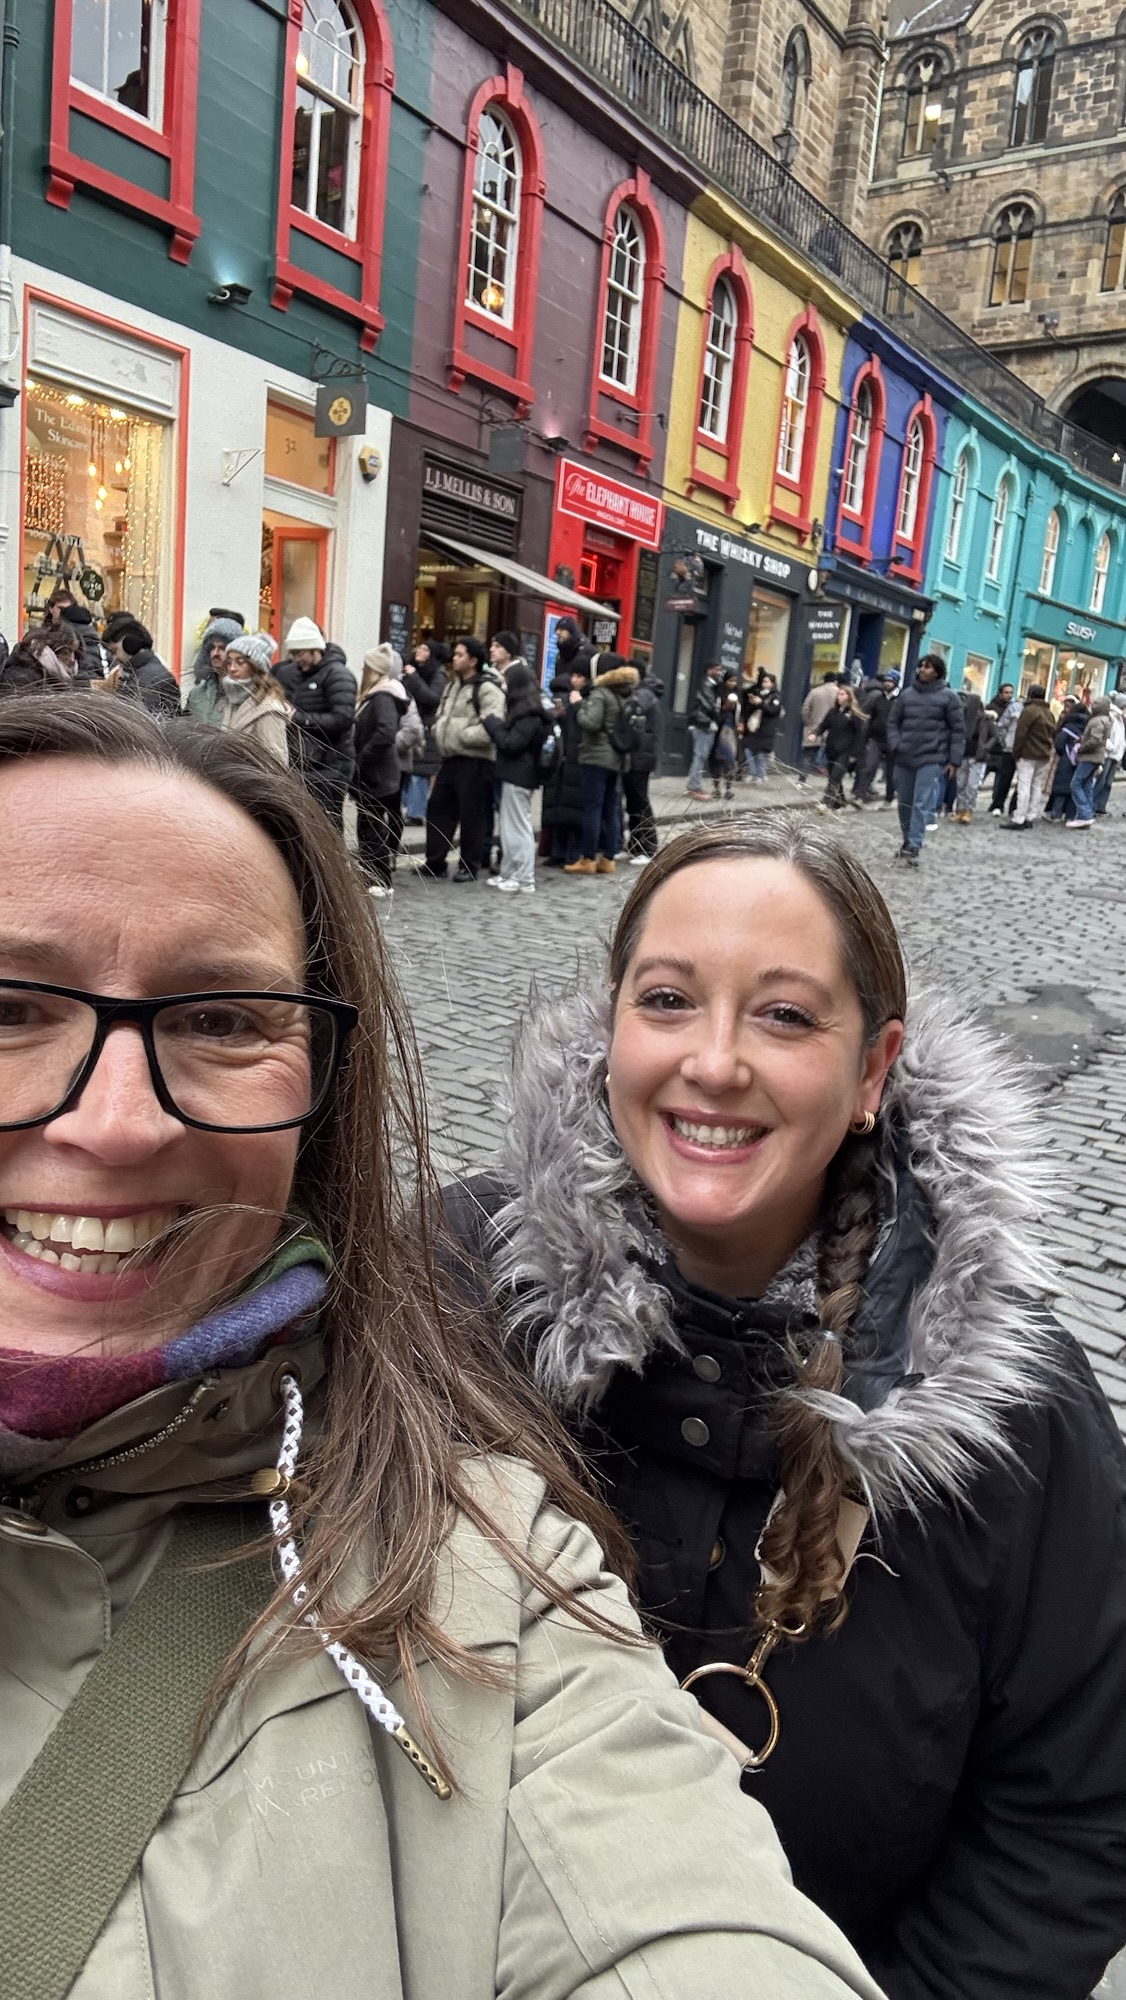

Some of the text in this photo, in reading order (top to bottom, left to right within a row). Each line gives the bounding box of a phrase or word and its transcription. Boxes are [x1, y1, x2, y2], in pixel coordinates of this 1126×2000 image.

[35, 407, 56, 426] The
[285, 437, 296, 455] 32
[483, 489, 492, 507] &
[492, 492, 516, 515] SON
[565, 472, 590, 497] The
[585, 481, 630, 518] ELEPHANT
[629, 499, 657, 528] HOUSE
[696, 528, 791, 579] THE WHISKY SHOP
[817, 610, 834, 619] THE
[808, 621, 841, 630] WHISKY
[1065, 621, 1097, 642] SWISH
[811, 632, 834, 640] SHOP
